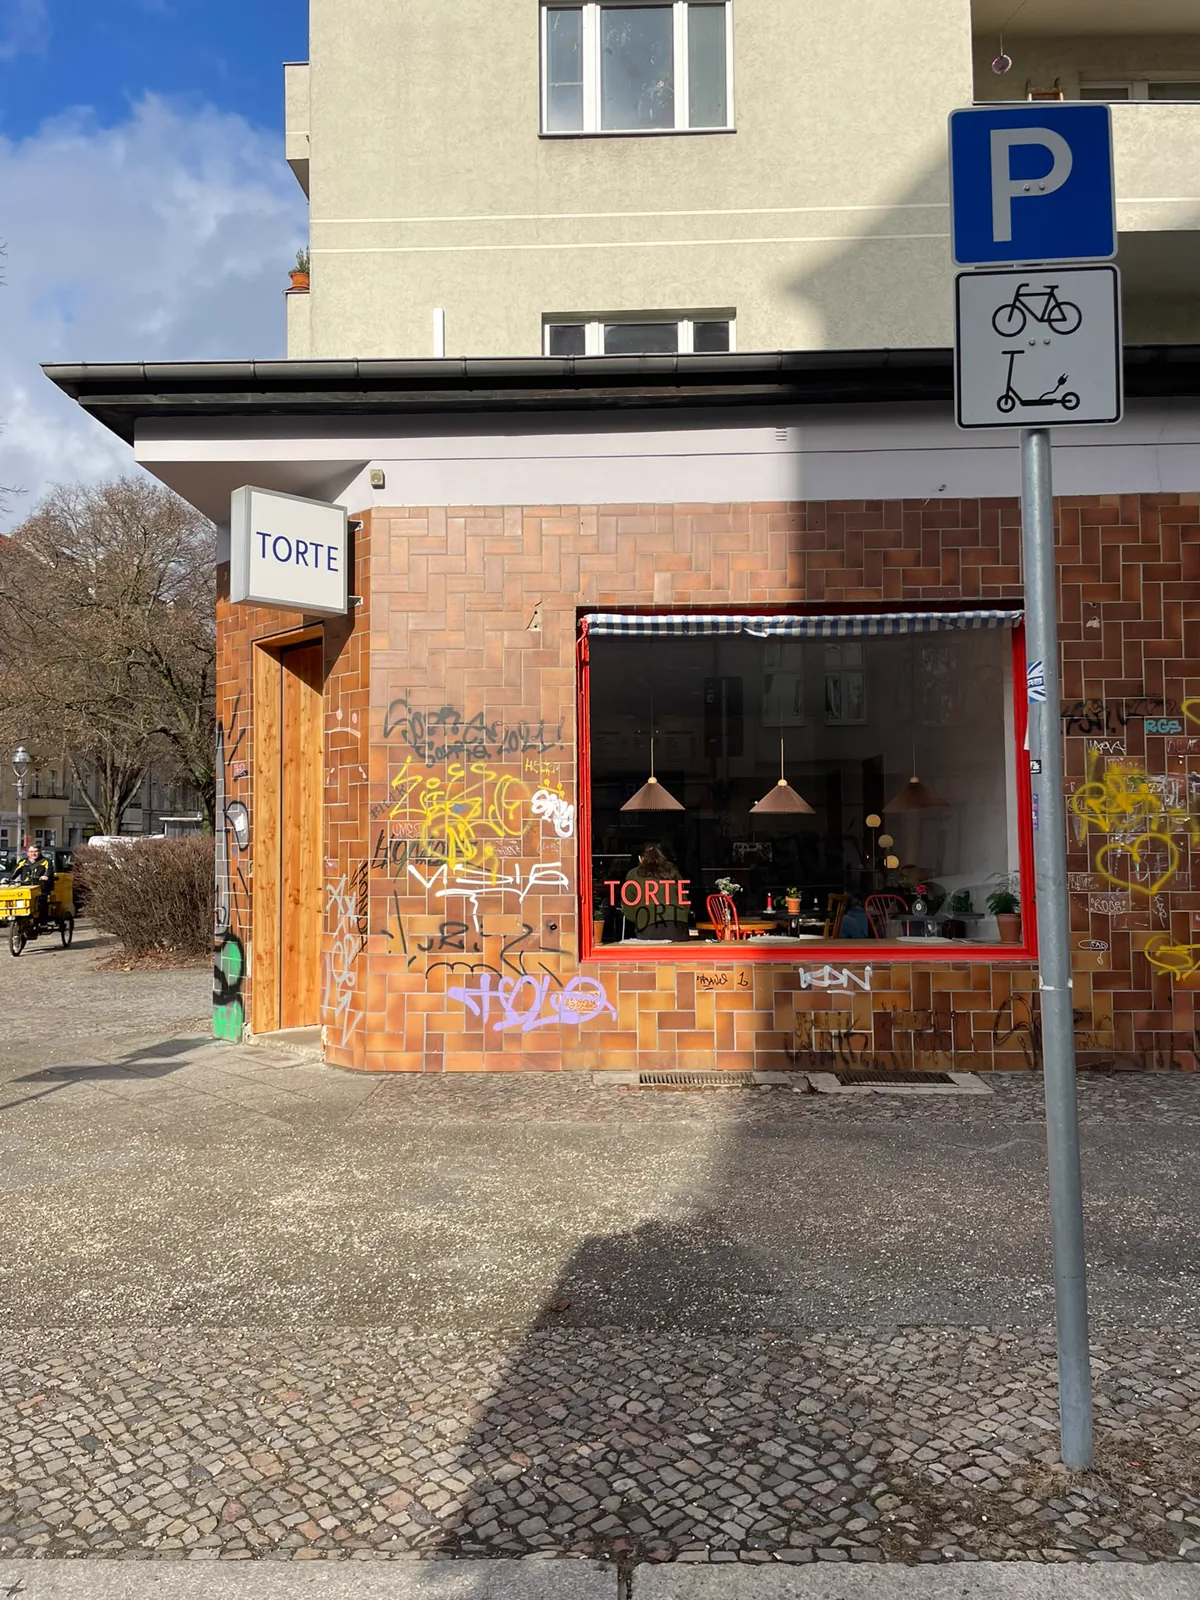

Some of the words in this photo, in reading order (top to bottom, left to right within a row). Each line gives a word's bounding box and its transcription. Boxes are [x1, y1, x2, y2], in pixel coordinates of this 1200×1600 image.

[990, 127, 1073, 242] P
[255, 531, 339, 572] TORTE
[1145, 719, 1182, 734] RGS
[604, 879, 692, 906] TORTE
